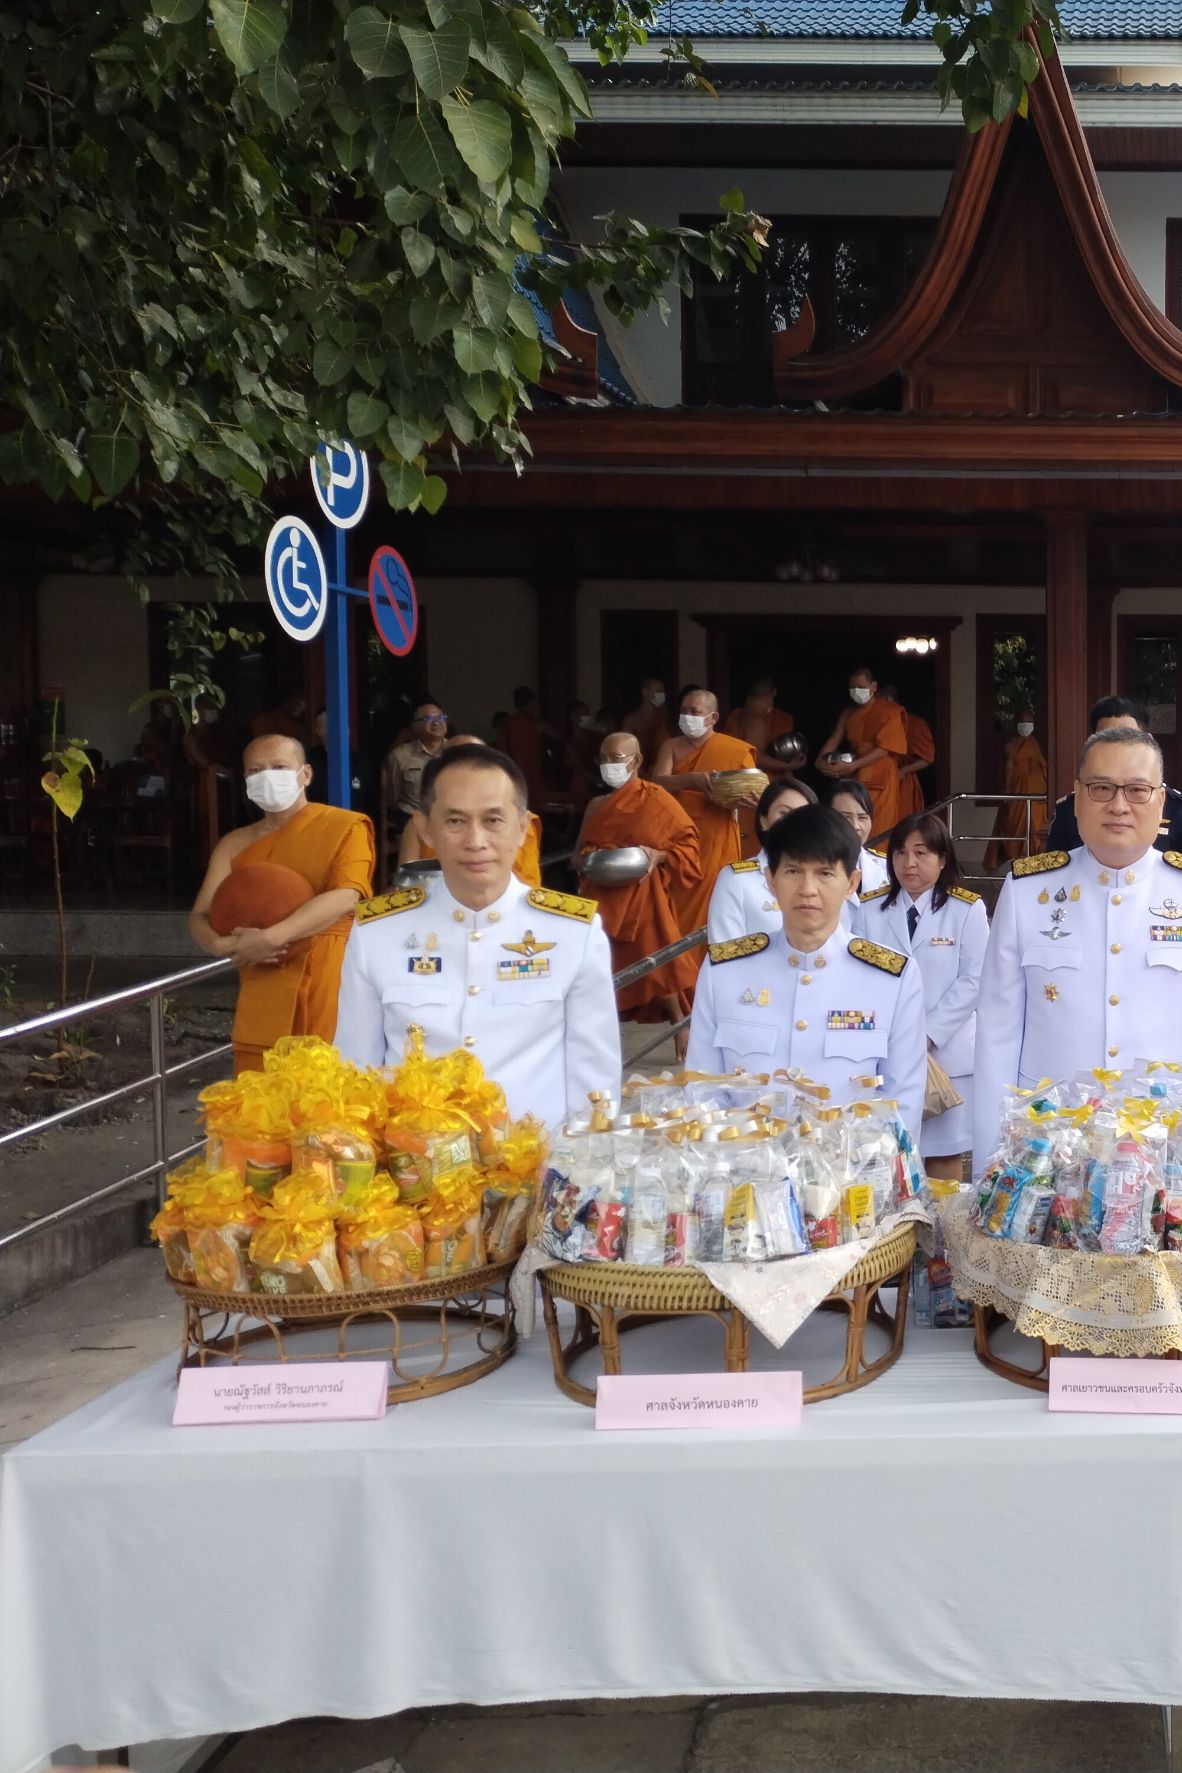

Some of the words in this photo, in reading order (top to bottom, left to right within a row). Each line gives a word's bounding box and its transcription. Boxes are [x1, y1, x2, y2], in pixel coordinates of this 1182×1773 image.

[325, 440, 357, 506] P
[646, 1397, 759, 1412] ศาลจังหวัดหนองคาย
